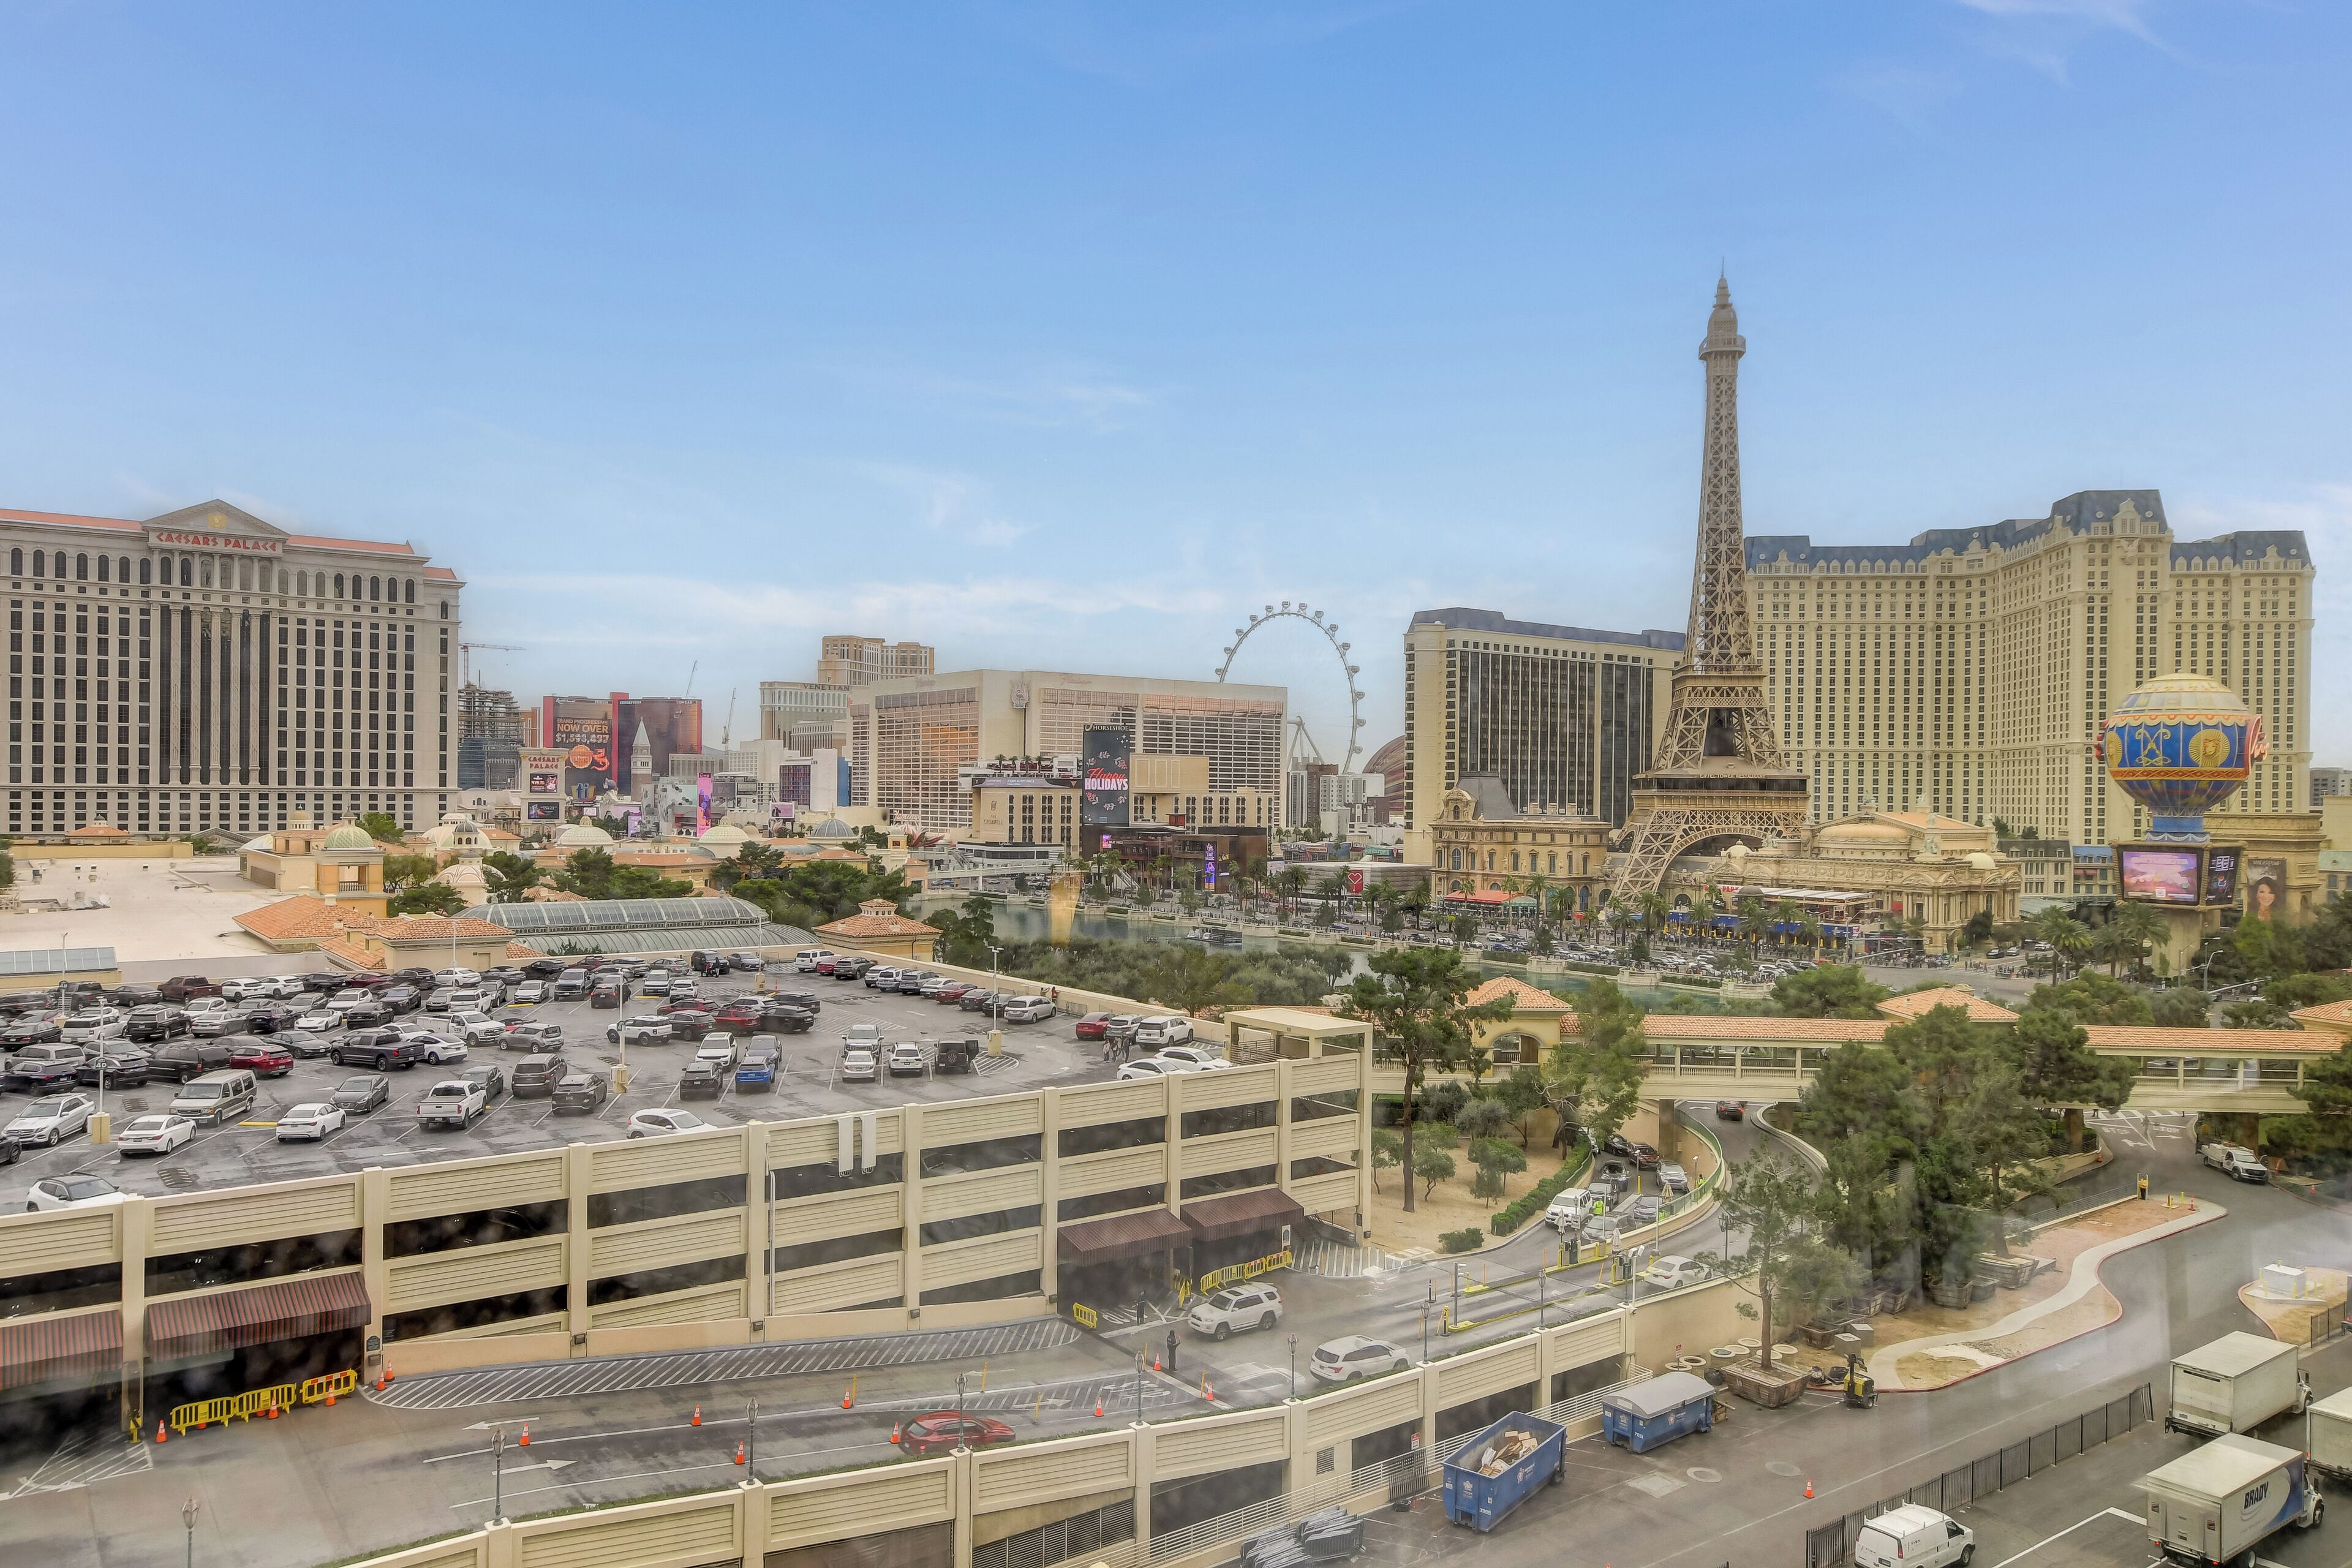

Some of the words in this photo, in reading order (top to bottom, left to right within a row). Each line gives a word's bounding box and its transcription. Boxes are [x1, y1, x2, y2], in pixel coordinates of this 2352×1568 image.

[156, 532, 218, 546] CAESARS
[224, 538, 276, 552] PALACE
[557, 724, 580, 733] NOW
[582, 725, 609, 733] OVER
[1087, 767, 1126, 779] Happy
[576, 783, 589, 799] ti
[1085, 778, 1128, 791] HOLIDAYS
[2244, 1481, 2269, 1510] BRADY
